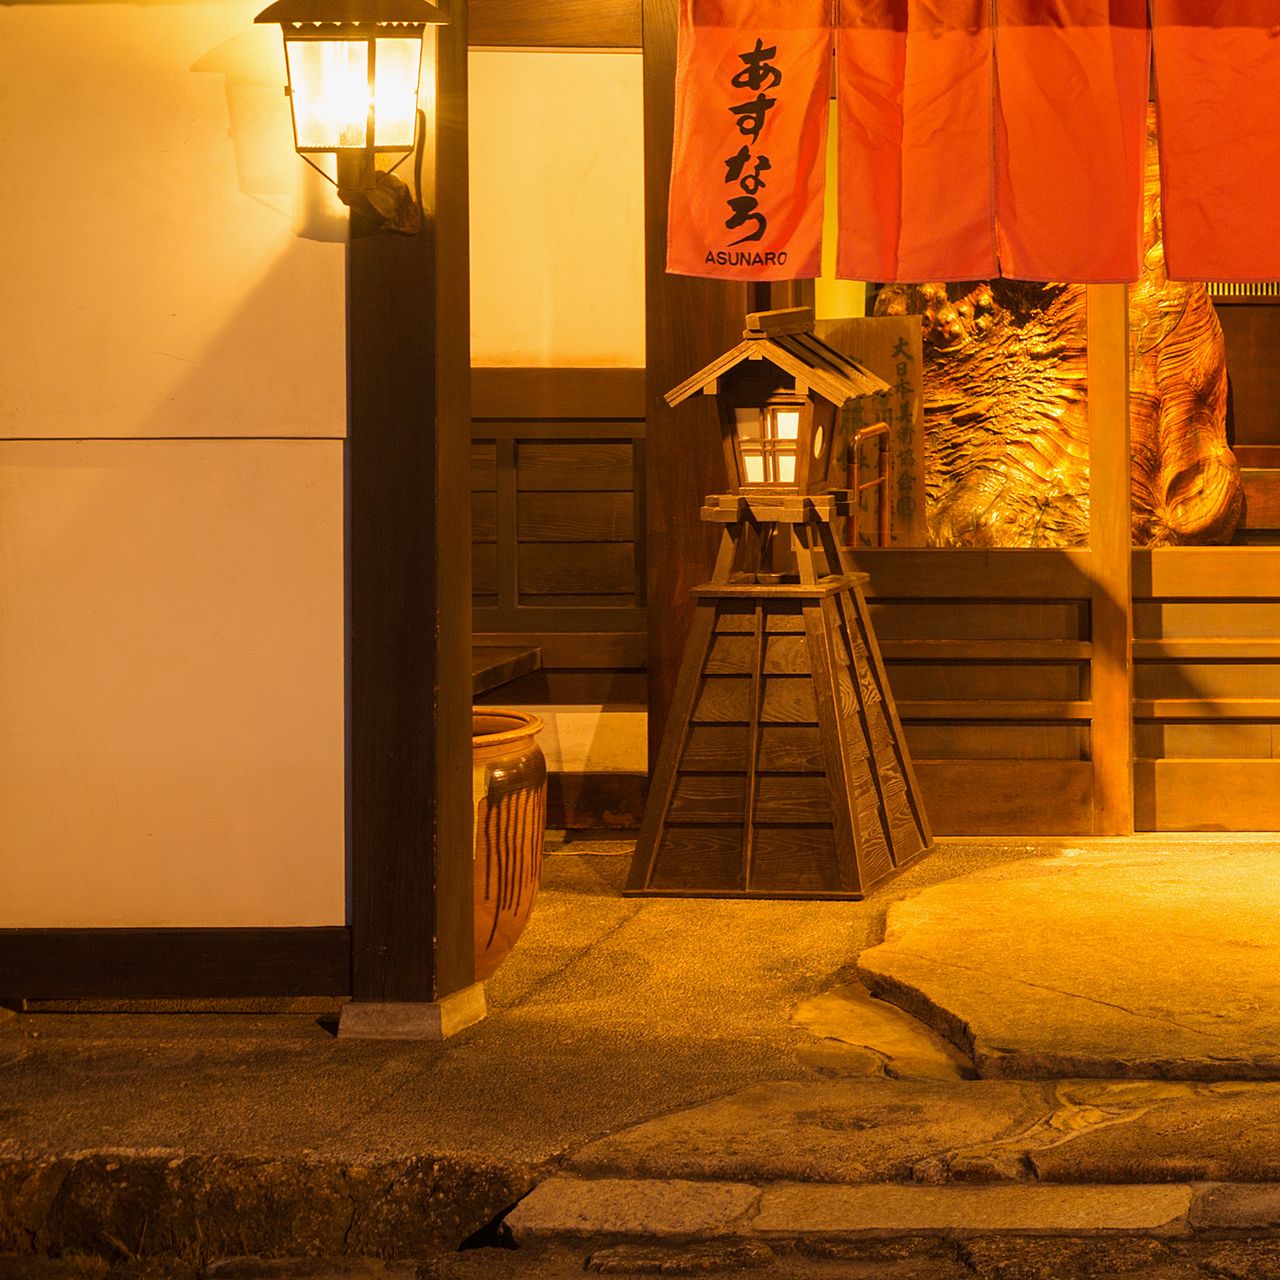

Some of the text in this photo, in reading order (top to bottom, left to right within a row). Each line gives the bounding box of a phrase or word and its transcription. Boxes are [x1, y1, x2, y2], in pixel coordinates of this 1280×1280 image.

[724, 37, 782, 247] あすなろ
[705, 251, 788, 267] ASUNARO
